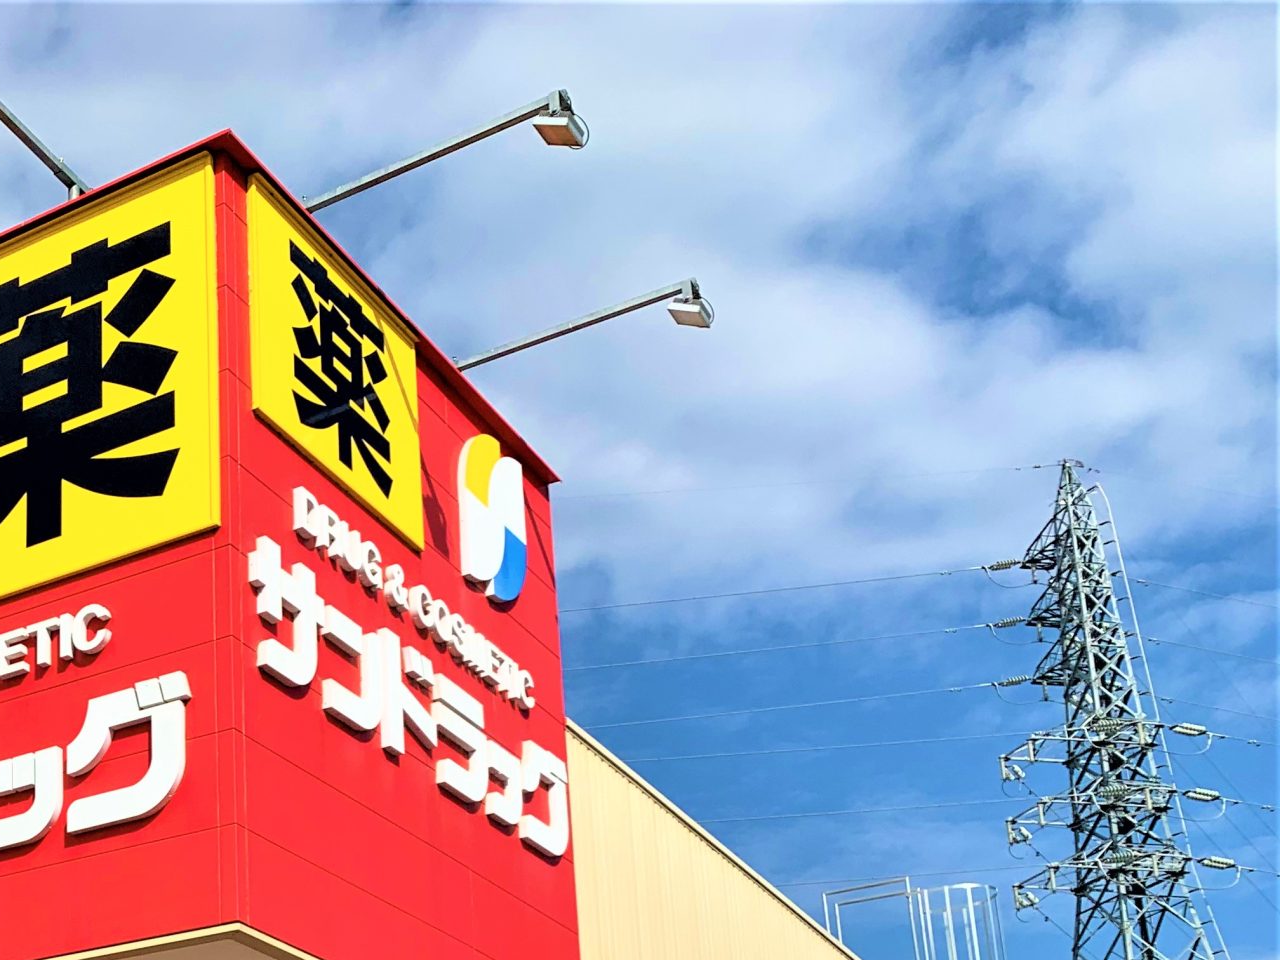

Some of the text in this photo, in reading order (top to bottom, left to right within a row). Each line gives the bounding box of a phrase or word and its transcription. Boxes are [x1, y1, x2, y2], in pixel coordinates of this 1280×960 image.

[289, 238, 394, 499] 薬
[247, 535, 569, 857] サンドラッグ
[292, 485, 536, 710] DRUG & COSMETIC
